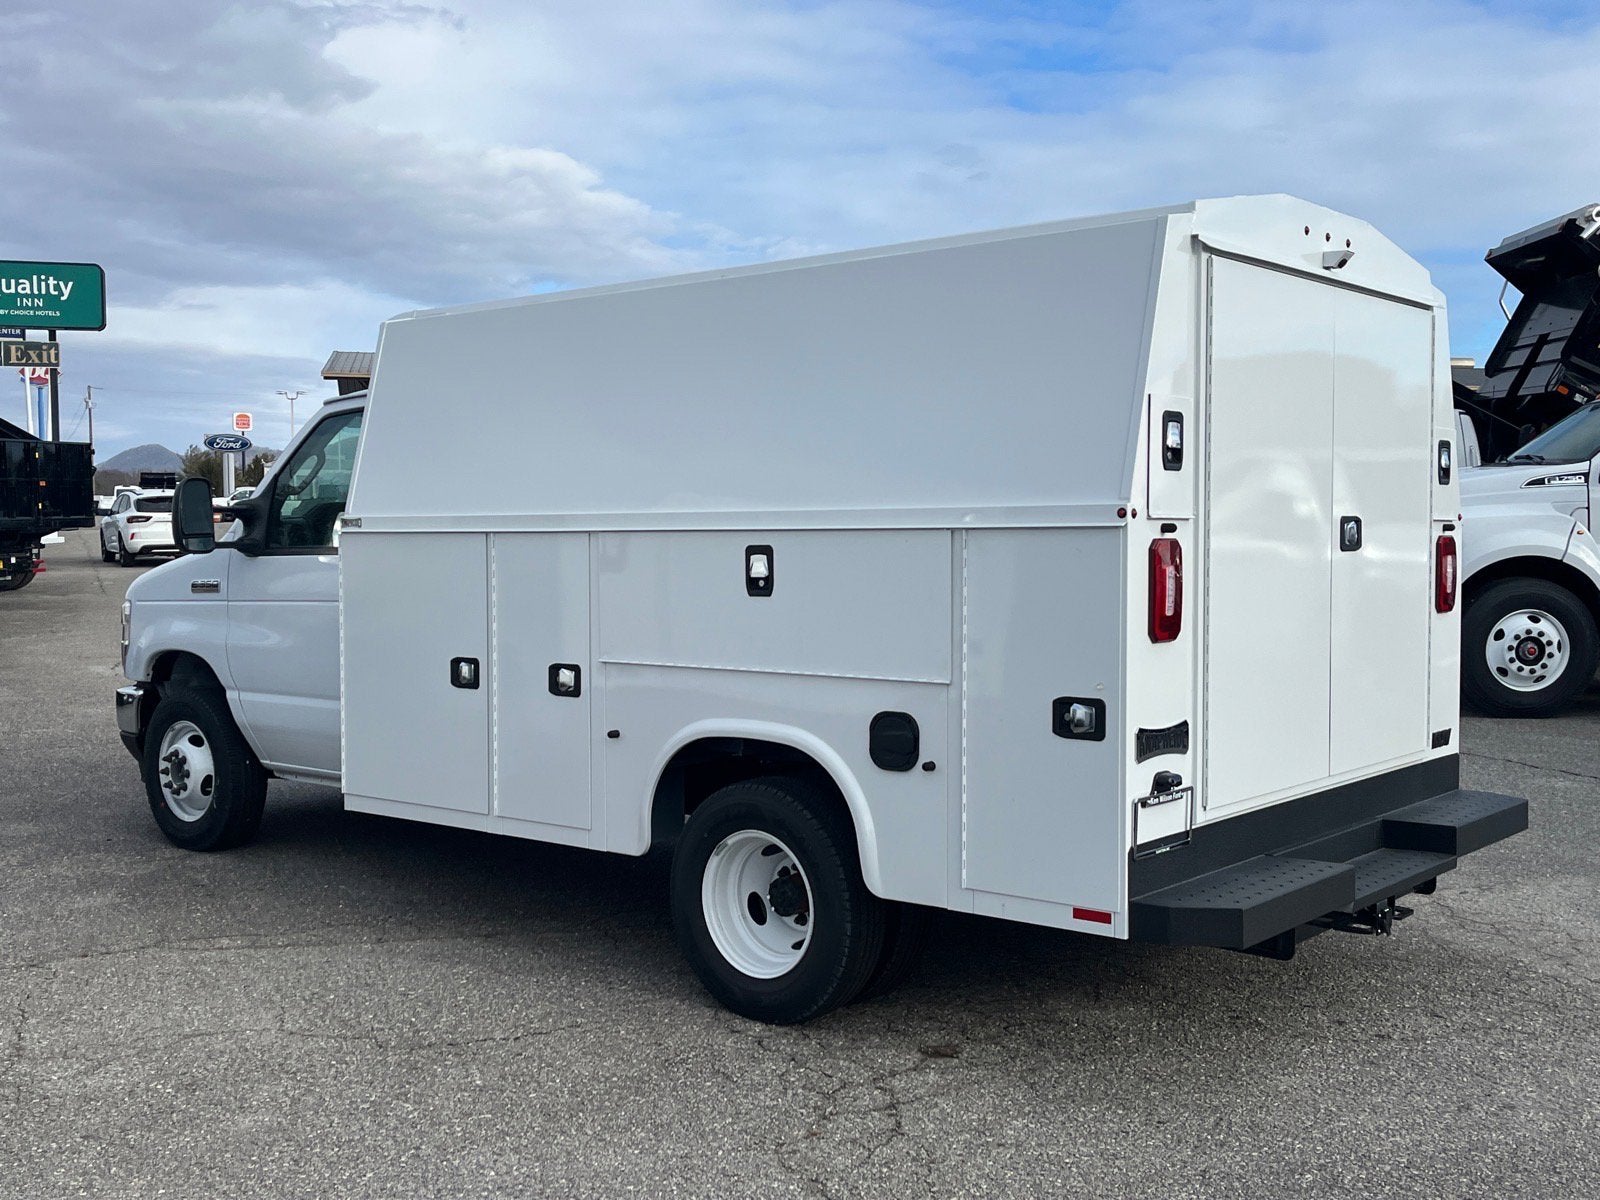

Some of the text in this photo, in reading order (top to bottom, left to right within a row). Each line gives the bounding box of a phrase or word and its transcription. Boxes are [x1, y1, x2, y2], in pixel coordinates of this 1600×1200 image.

[0, 274, 73, 300] uality
[17, 297, 43, 307] INN
[8, 344, 58, 364] Exit
[213, 437, 241, 449] Ford
